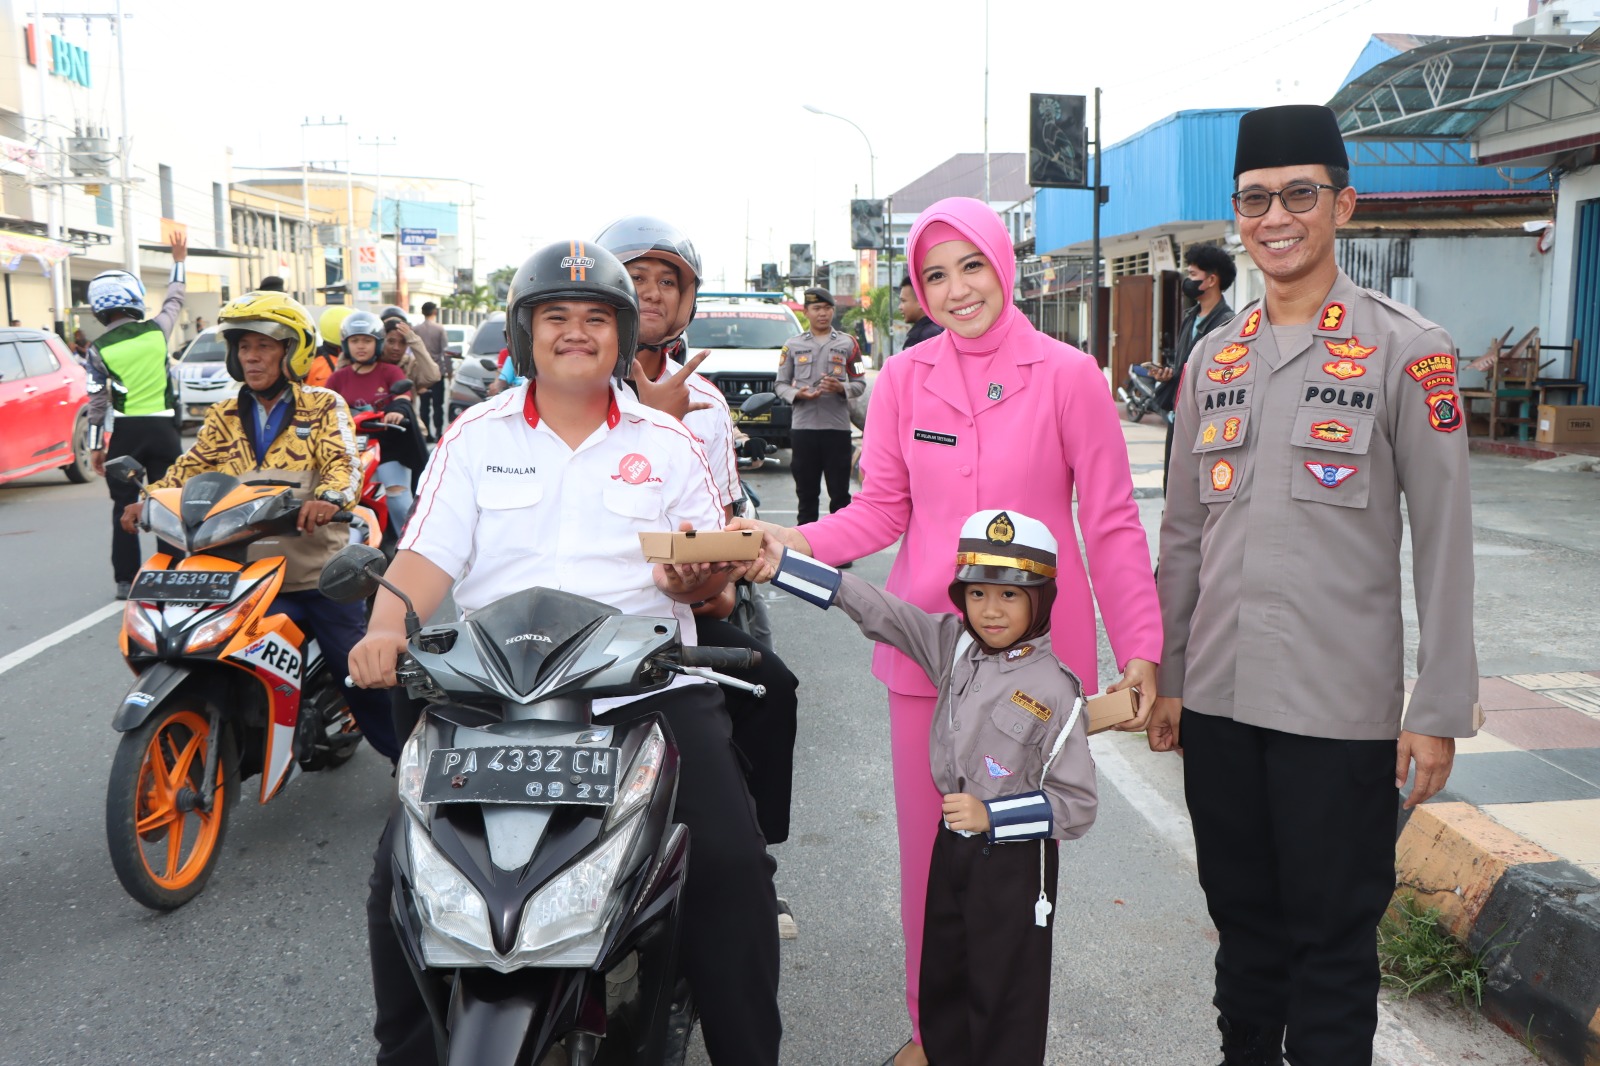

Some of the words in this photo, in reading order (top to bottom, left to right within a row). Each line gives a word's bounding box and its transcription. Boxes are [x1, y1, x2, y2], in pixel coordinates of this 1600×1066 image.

[404, 235, 425, 244] ATM
[739, 312, 787, 320] NUMFOR
[1411, 356, 1452, 371] POLRES
[1427, 378, 1451, 387] PAPUA
[1204, 389, 1247, 411] ARIE
[1305, 386, 1374, 410] POLRI
[486, 465, 536, 475] PENJUALAN
[628, 460, 640, 473] One
[141, 572, 163, 584] PA
[166, 572, 209, 585] 3639
[209, 573, 233, 585] CK
[504, 633, 553, 646] HONDA
[443, 751, 478, 775] PA
[487, 749, 563, 773] 4332
[572, 751, 609, 775] CH
[576, 783, 609, 798] 27
